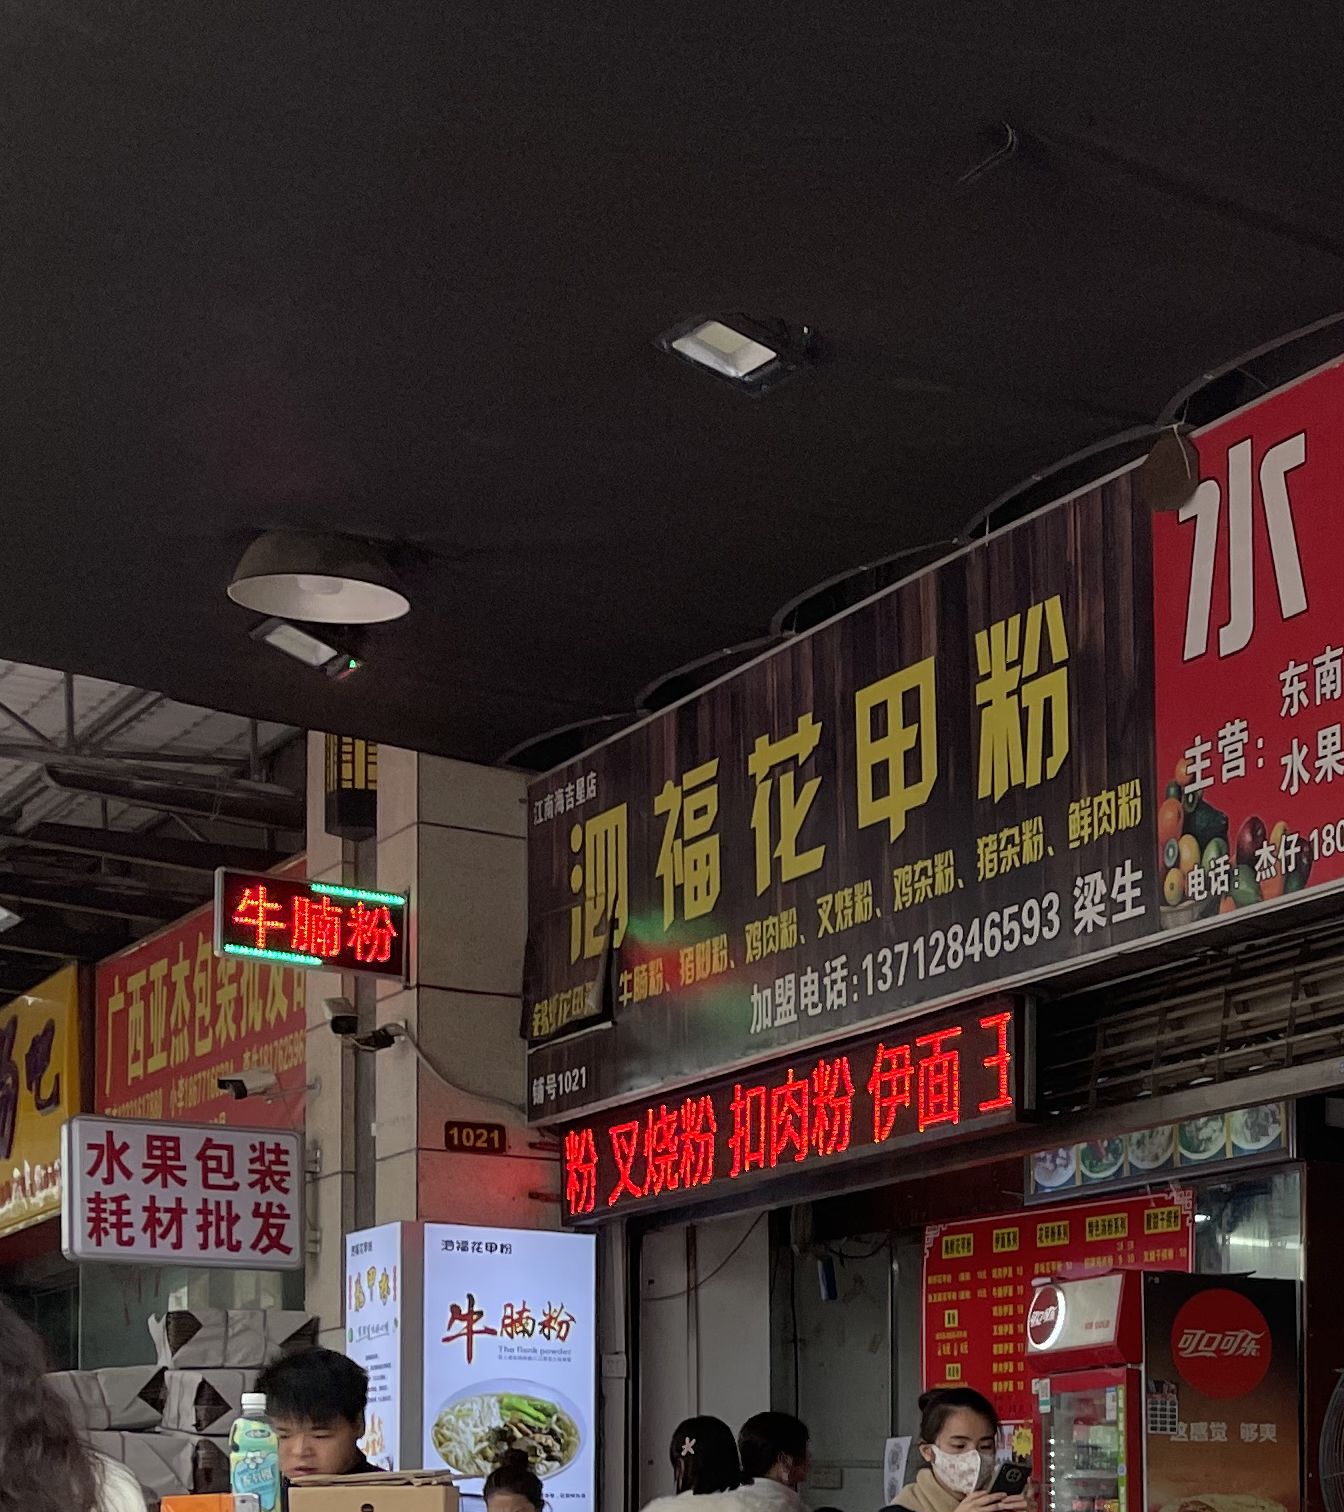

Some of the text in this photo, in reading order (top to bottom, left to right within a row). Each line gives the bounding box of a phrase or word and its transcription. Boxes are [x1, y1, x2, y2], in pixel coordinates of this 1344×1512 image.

[533, 770, 598, 826] 江南海吉星店
[569, 594, 1071, 965] 泗福花甲粉
[1253, 833, 1301, 881] 杰仔
[231, 885, 398, 963] 牛腩粉
[1073, 859, 1147, 937] 梁生
[447, 1126, 502, 1151] 1021
[608, 1097, 718, 1206] 叉烧粉
[728, 1056, 856, 1178] 扣肉粉
[867, 1025, 962, 1144] 伊面
[86, 1130, 292, 1194] 水果包装
[86, 1195, 294, 1256] 耗材批发
[441, 1239, 513, 1255] 泗福花甲粉
[442, 1293, 577, 1366] 牛腩粉
[1177, 1328, 1266, 1359] 可口可乐
[1240, 1421, 1278, 1443] 够爽
